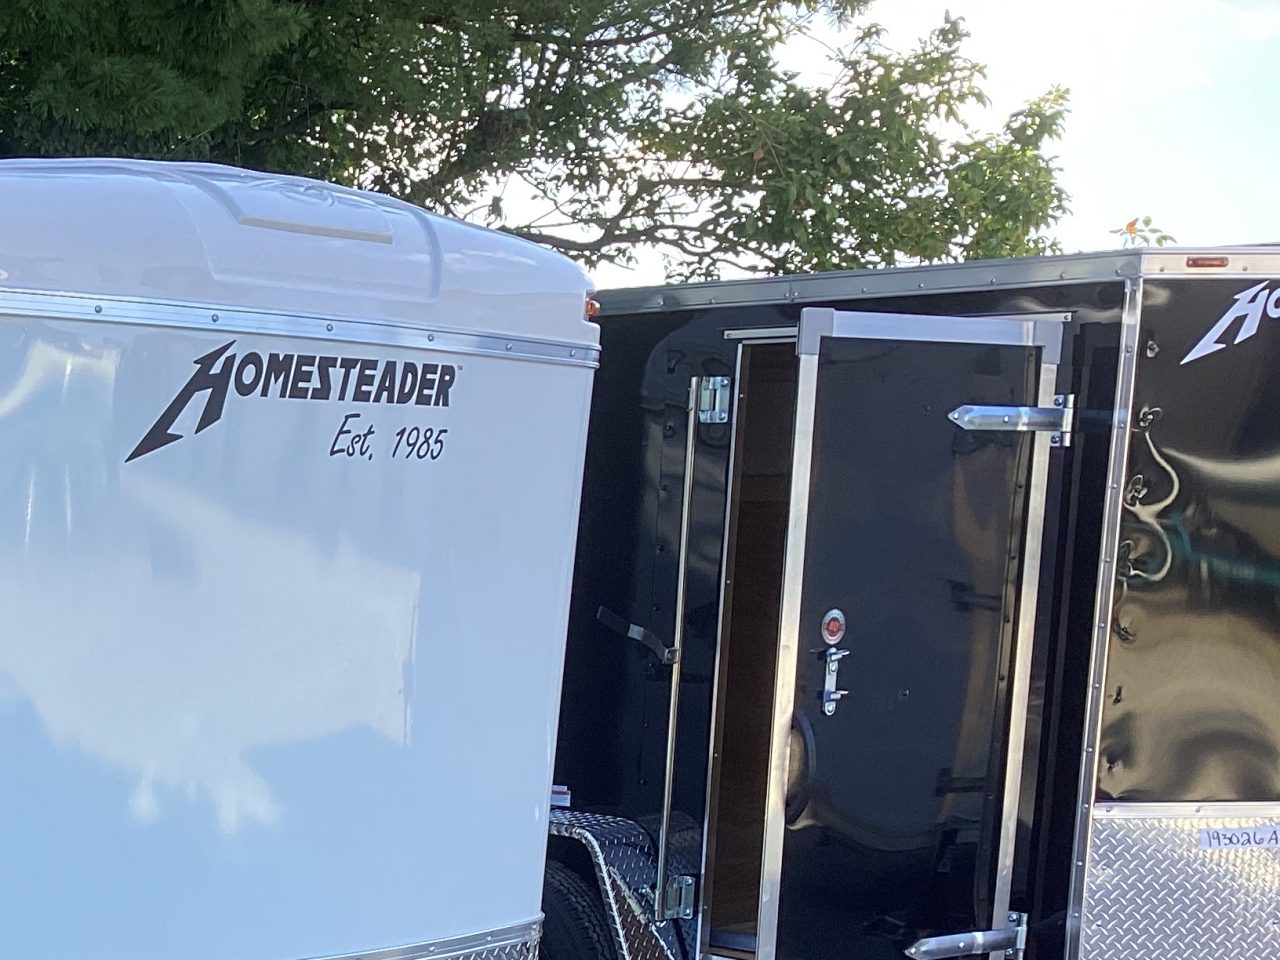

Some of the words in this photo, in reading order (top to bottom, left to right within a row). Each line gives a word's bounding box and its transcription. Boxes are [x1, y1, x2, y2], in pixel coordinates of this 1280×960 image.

[125, 340, 456, 462] HOMESTEADER
[391, 426, 448, 460] 1985
[1206, 830, 1264, 847] 193026
